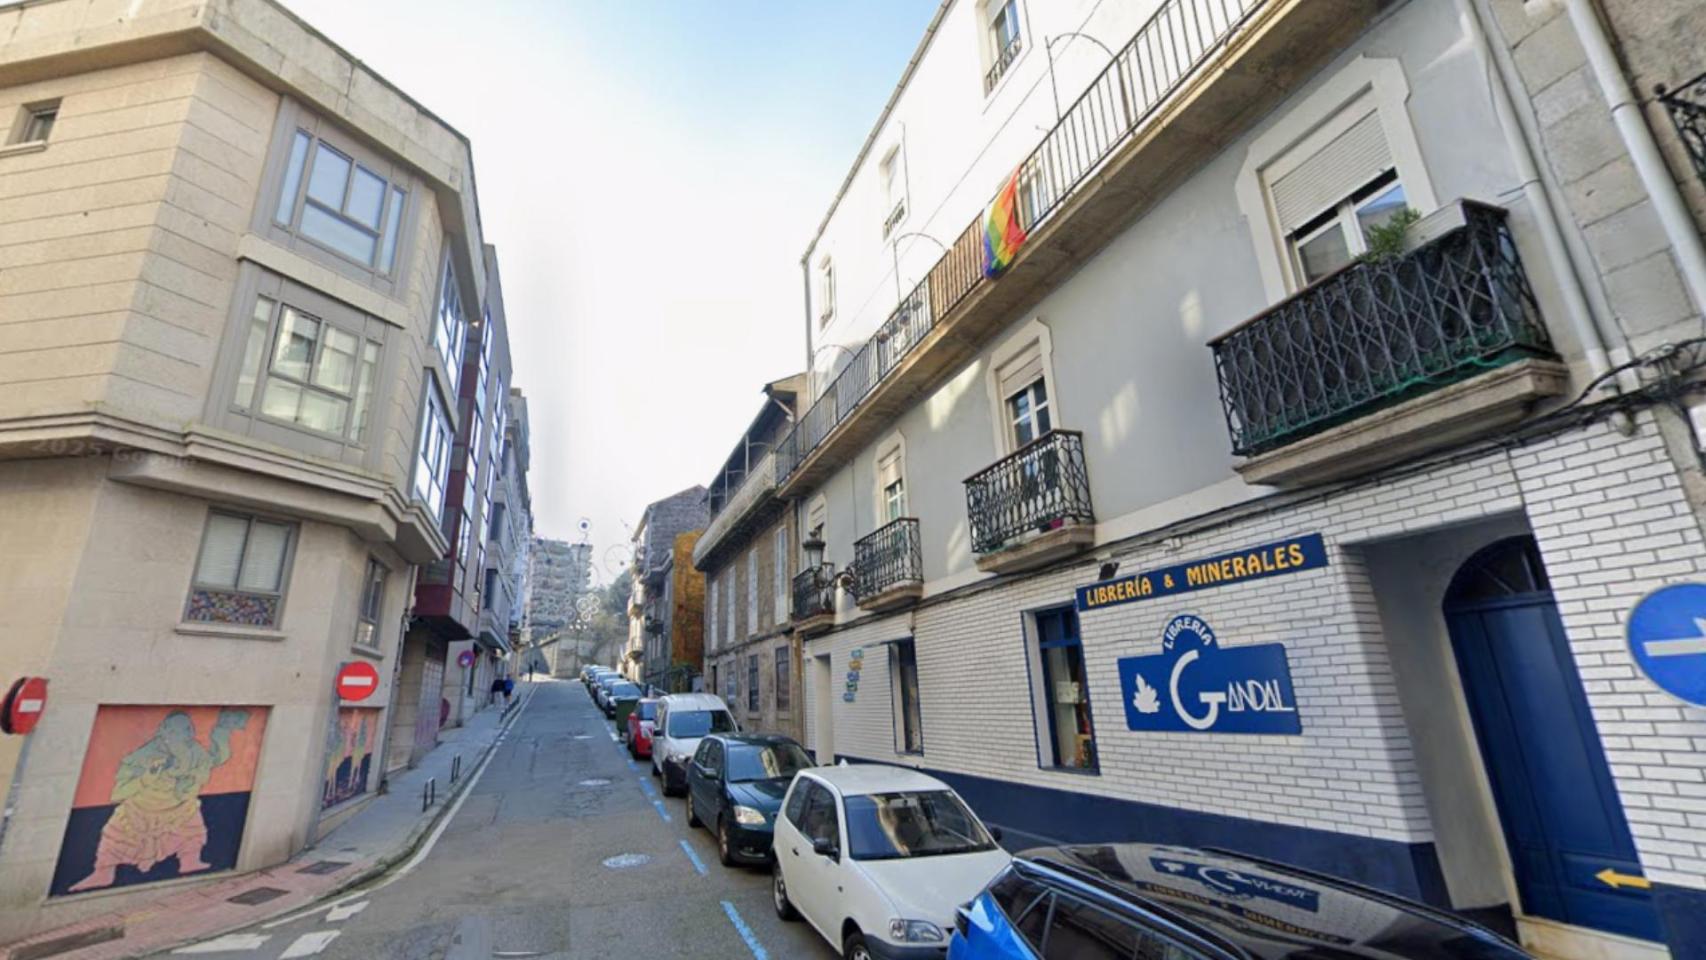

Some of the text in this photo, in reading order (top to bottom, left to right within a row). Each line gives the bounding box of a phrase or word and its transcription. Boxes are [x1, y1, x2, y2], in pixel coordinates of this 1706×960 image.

[1086, 543, 1305, 607] LIBRERÍA & MINERALES
[1164, 616, 1213, 650] LIBRERIA
